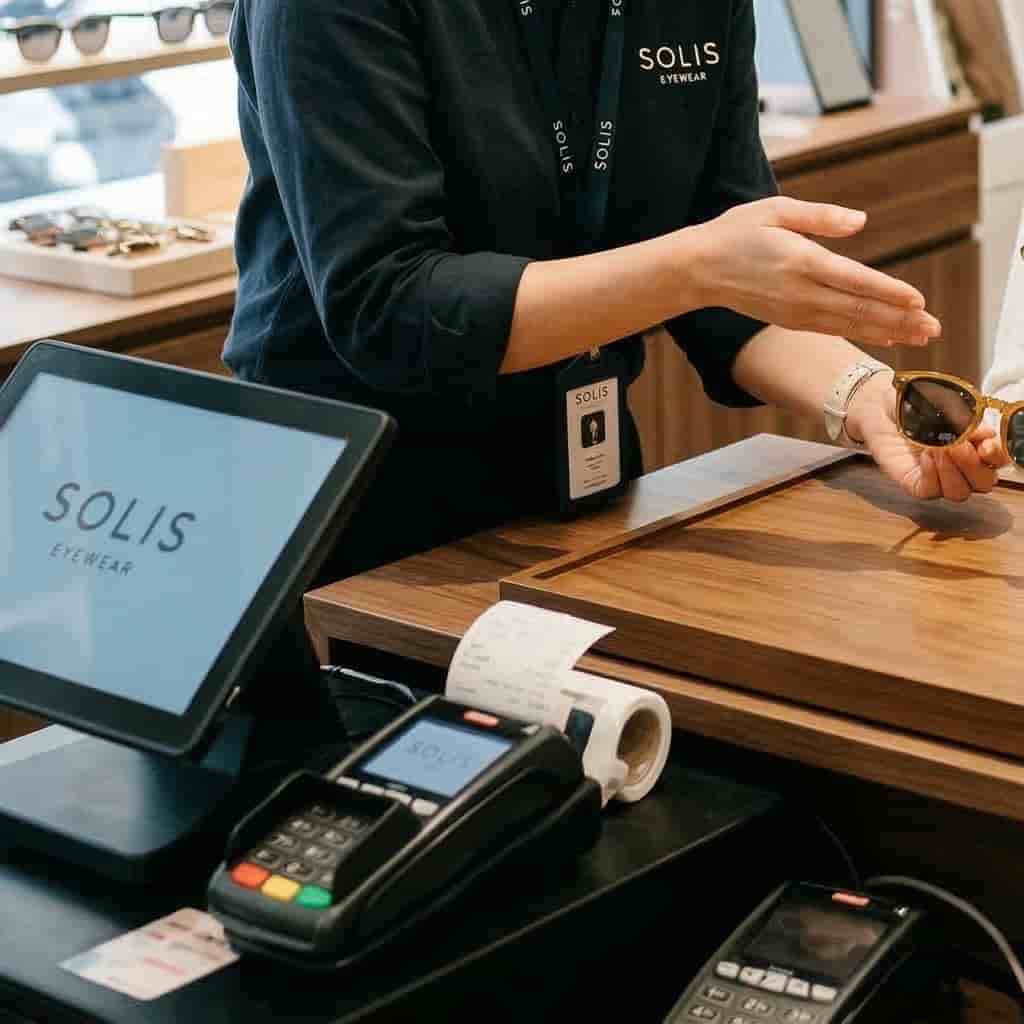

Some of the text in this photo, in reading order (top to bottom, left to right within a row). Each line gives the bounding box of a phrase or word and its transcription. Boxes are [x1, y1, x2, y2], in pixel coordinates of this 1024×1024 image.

[638, 42, 720, 70] SOLIS
[659, 72, 708, 85] EYEWEAR
[552, 120, 574, 174] SOLIS
[594, 120, 613, 171] SOLIS
[575, 386, 608, 405] SOLIS
[42, 481, 196, 553] SOLIS
[49, 543, 135, 577] EYEWEAR
